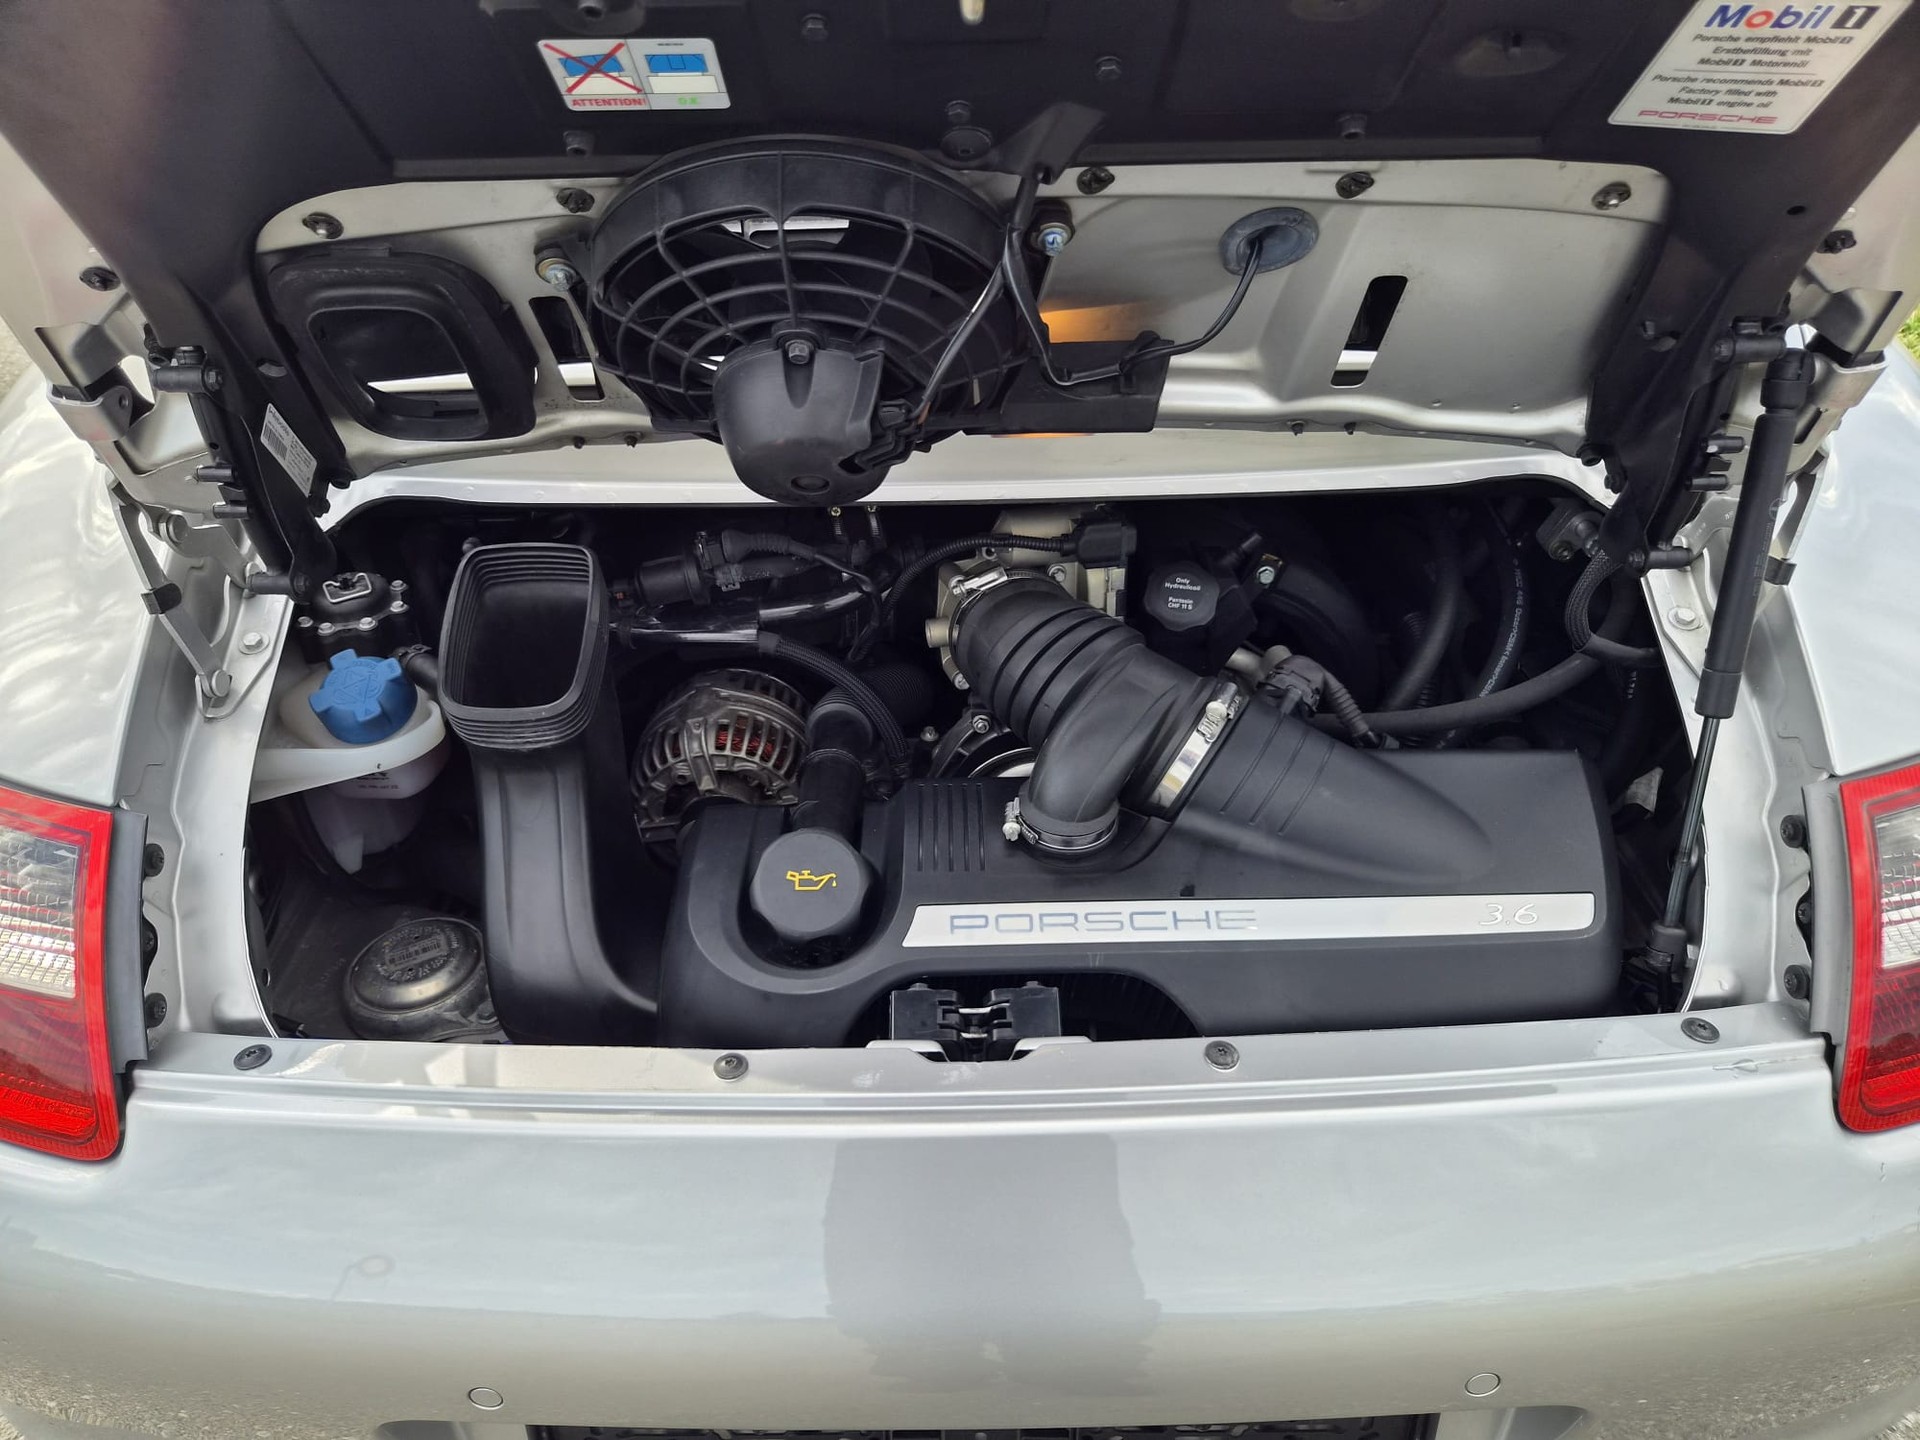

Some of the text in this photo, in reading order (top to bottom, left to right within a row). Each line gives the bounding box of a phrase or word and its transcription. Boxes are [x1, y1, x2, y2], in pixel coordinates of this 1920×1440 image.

[1704, 5, 1836, 30] Mobil
[1692, 33, 1741, 43] Porsche
[1745, 35, 1801, 44] empfiehlt
[1790, 48, 1813, 56] mit
[1652, 74, 1698, 84] Porsche
[1700, 76, 1775, 87] recommends
[1678, 86, 1778, 98] Factory filled with
[572, 97, 647, 107] ATTENTION!
[1716, 99, 1754, 109] engine
[1756, 100, 1773, 109] oil
[1637, 109, 1778, 124] PORSCHE
[1479, 903, 1538, 925] 3.6
[950, 910, 1256, 934] PORSCHE
